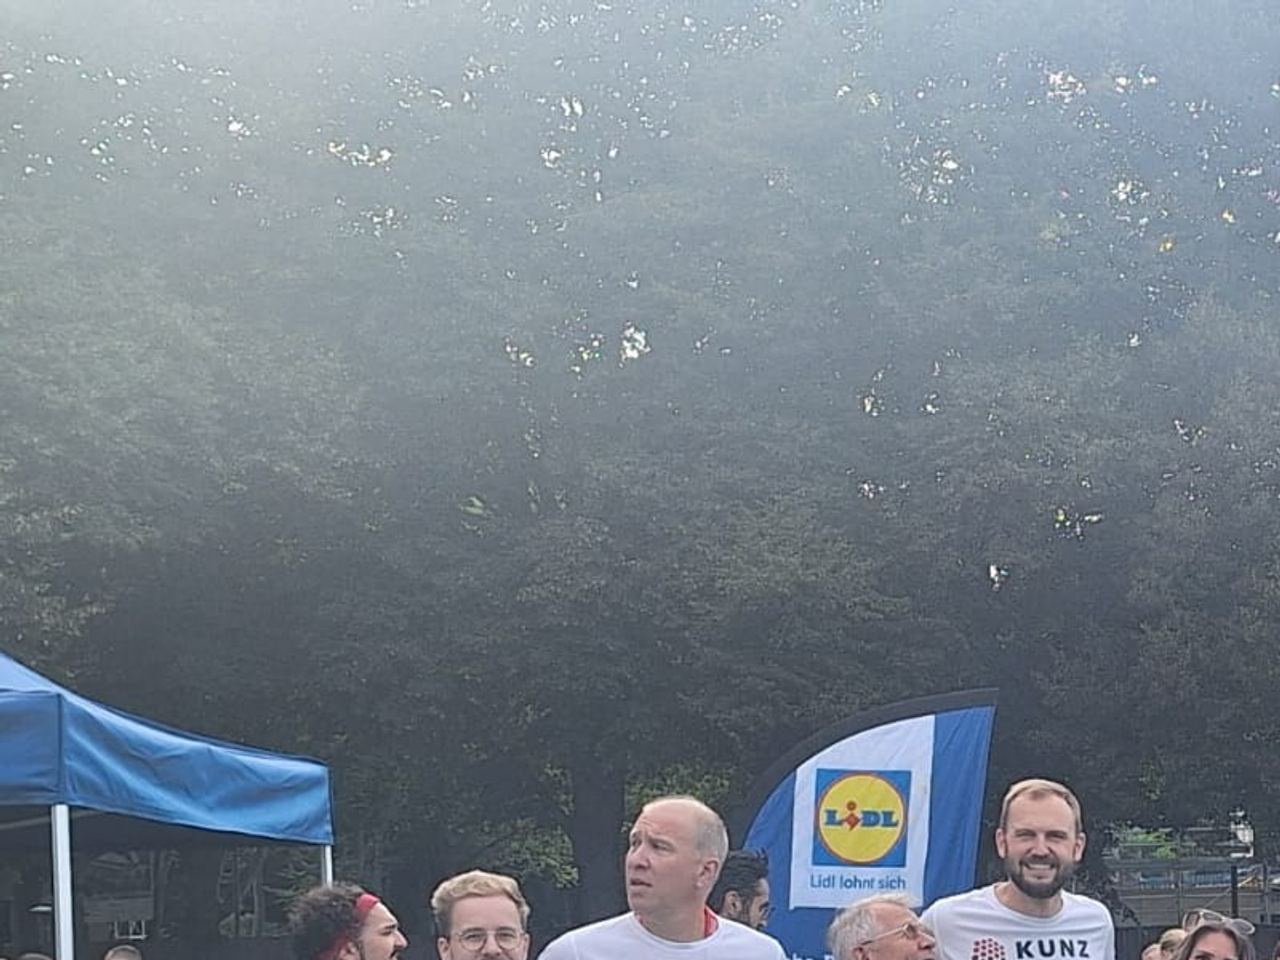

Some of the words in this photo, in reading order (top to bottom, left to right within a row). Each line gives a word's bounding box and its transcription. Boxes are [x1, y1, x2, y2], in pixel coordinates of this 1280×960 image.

[810, 874, 835, 889] Lidl
[840, 874, 875, 889] lohnt
[879, 875, 906, 890] sich
[1016, 939, 1090, 959] KUNZ
